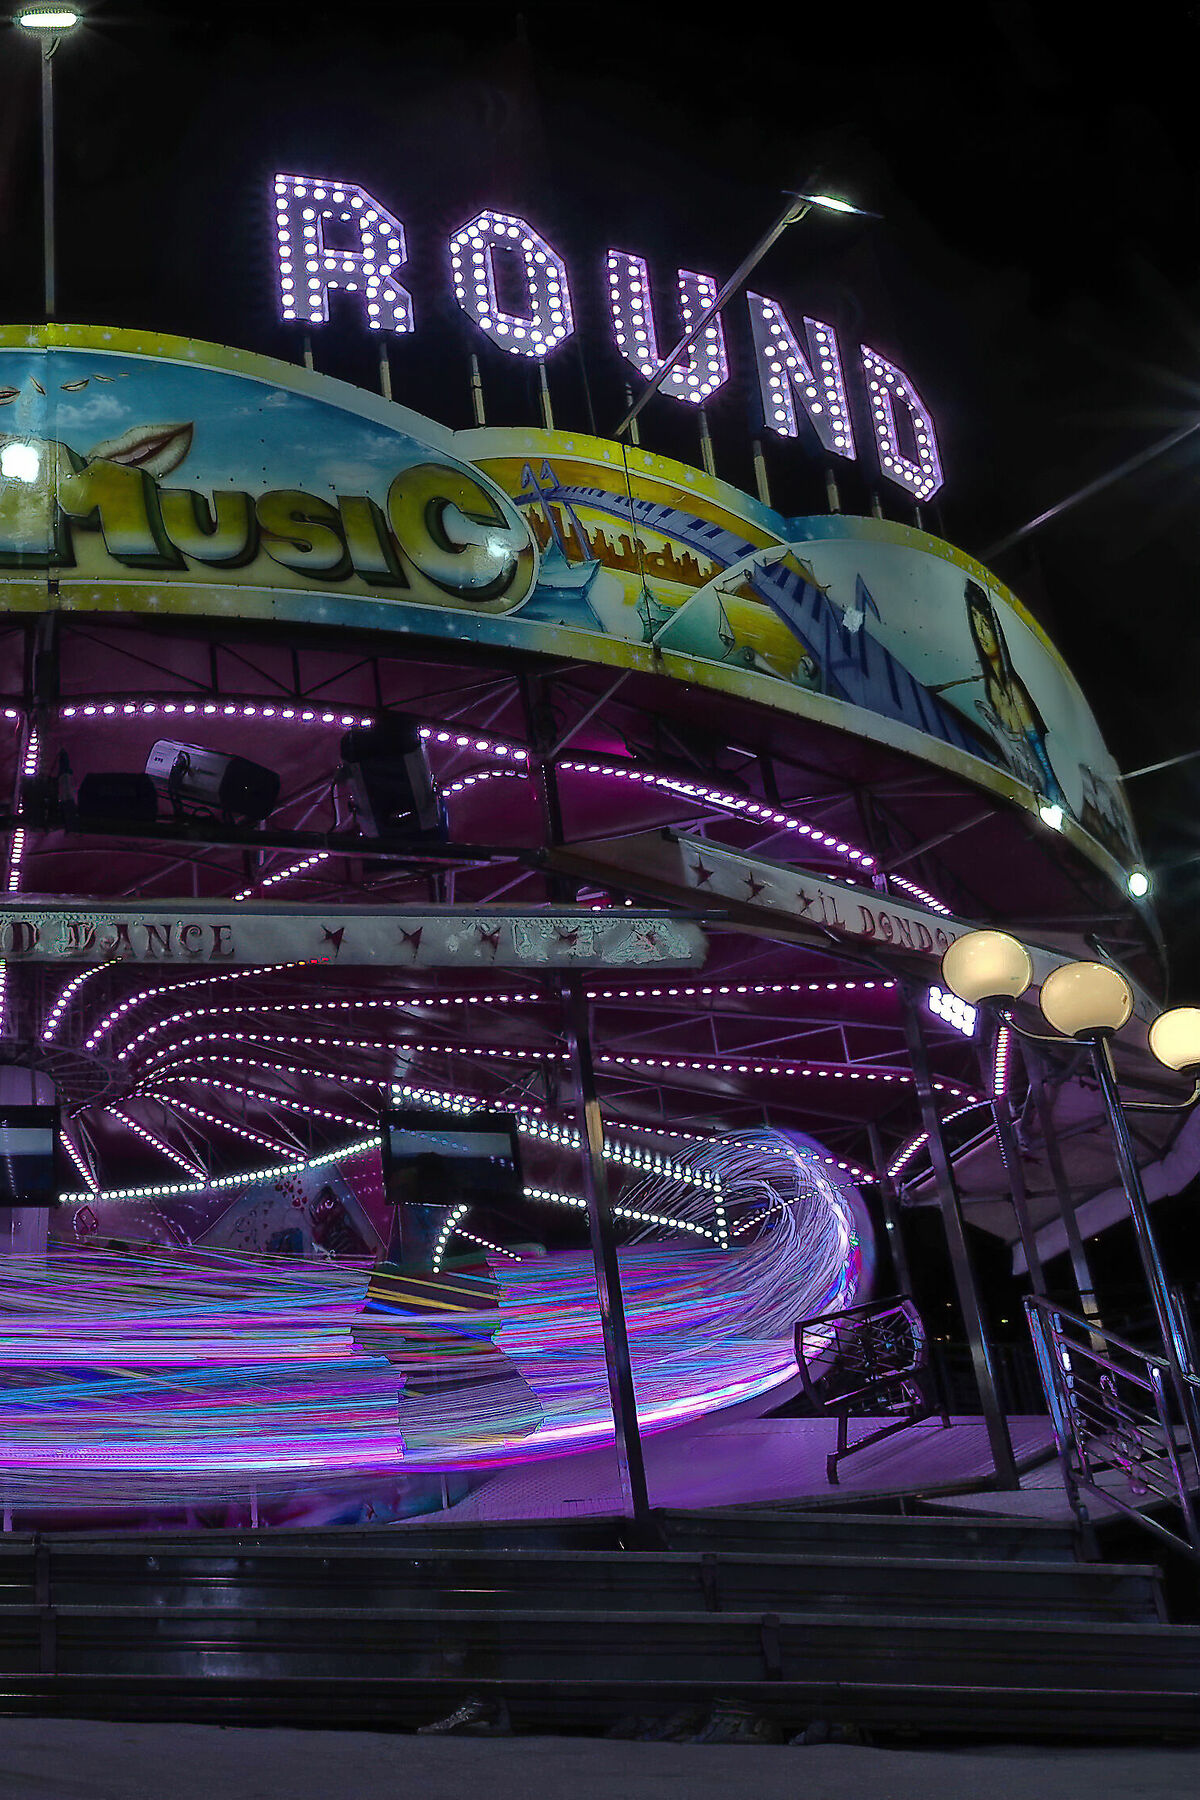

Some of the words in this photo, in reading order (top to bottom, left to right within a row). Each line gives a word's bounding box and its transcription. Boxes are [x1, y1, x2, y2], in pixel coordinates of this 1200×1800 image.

[274, 171, 947, 503] ROUND
[65, 920, 235, 960] DANCE
[857, 904, 956, 953] DONDO
